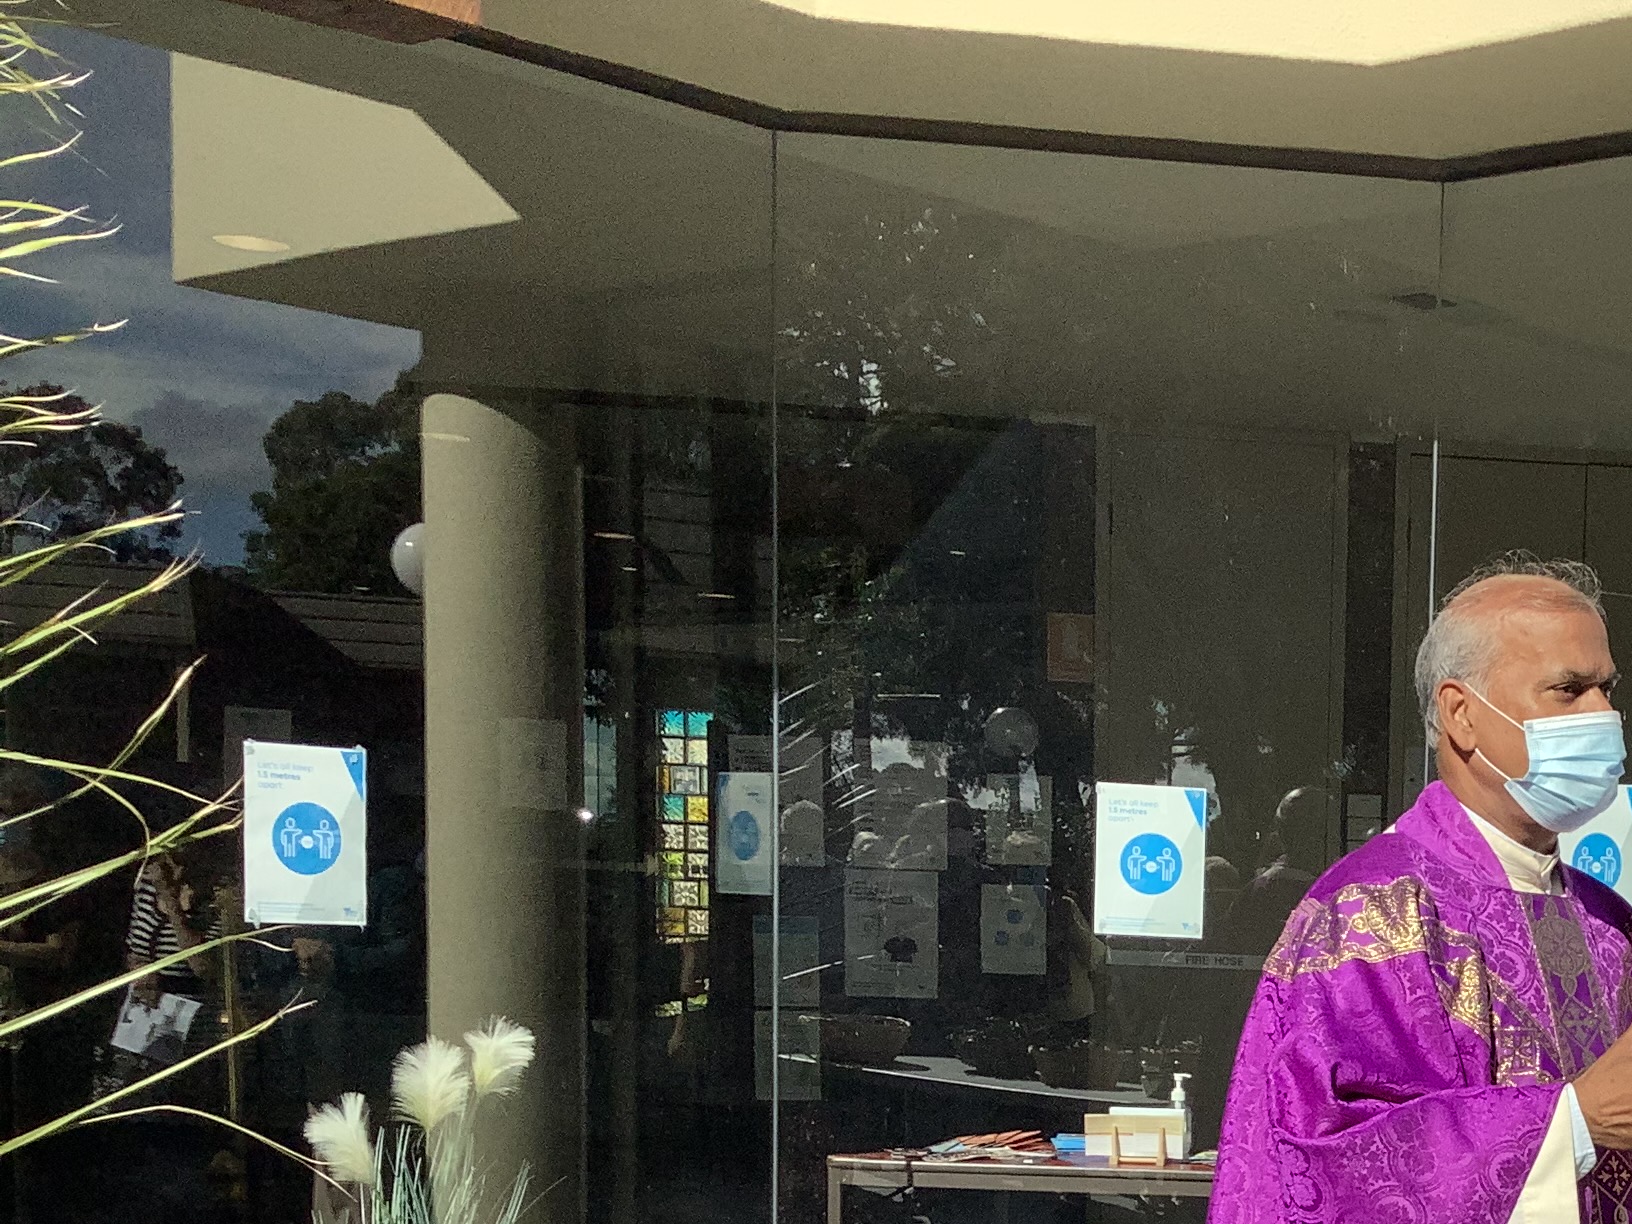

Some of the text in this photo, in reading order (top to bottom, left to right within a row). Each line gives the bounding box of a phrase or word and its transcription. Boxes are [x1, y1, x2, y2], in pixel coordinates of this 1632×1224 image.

[1119, 807, 1148, 815] metres
[1185, 955, 1244, 966] FIRE HOSE
